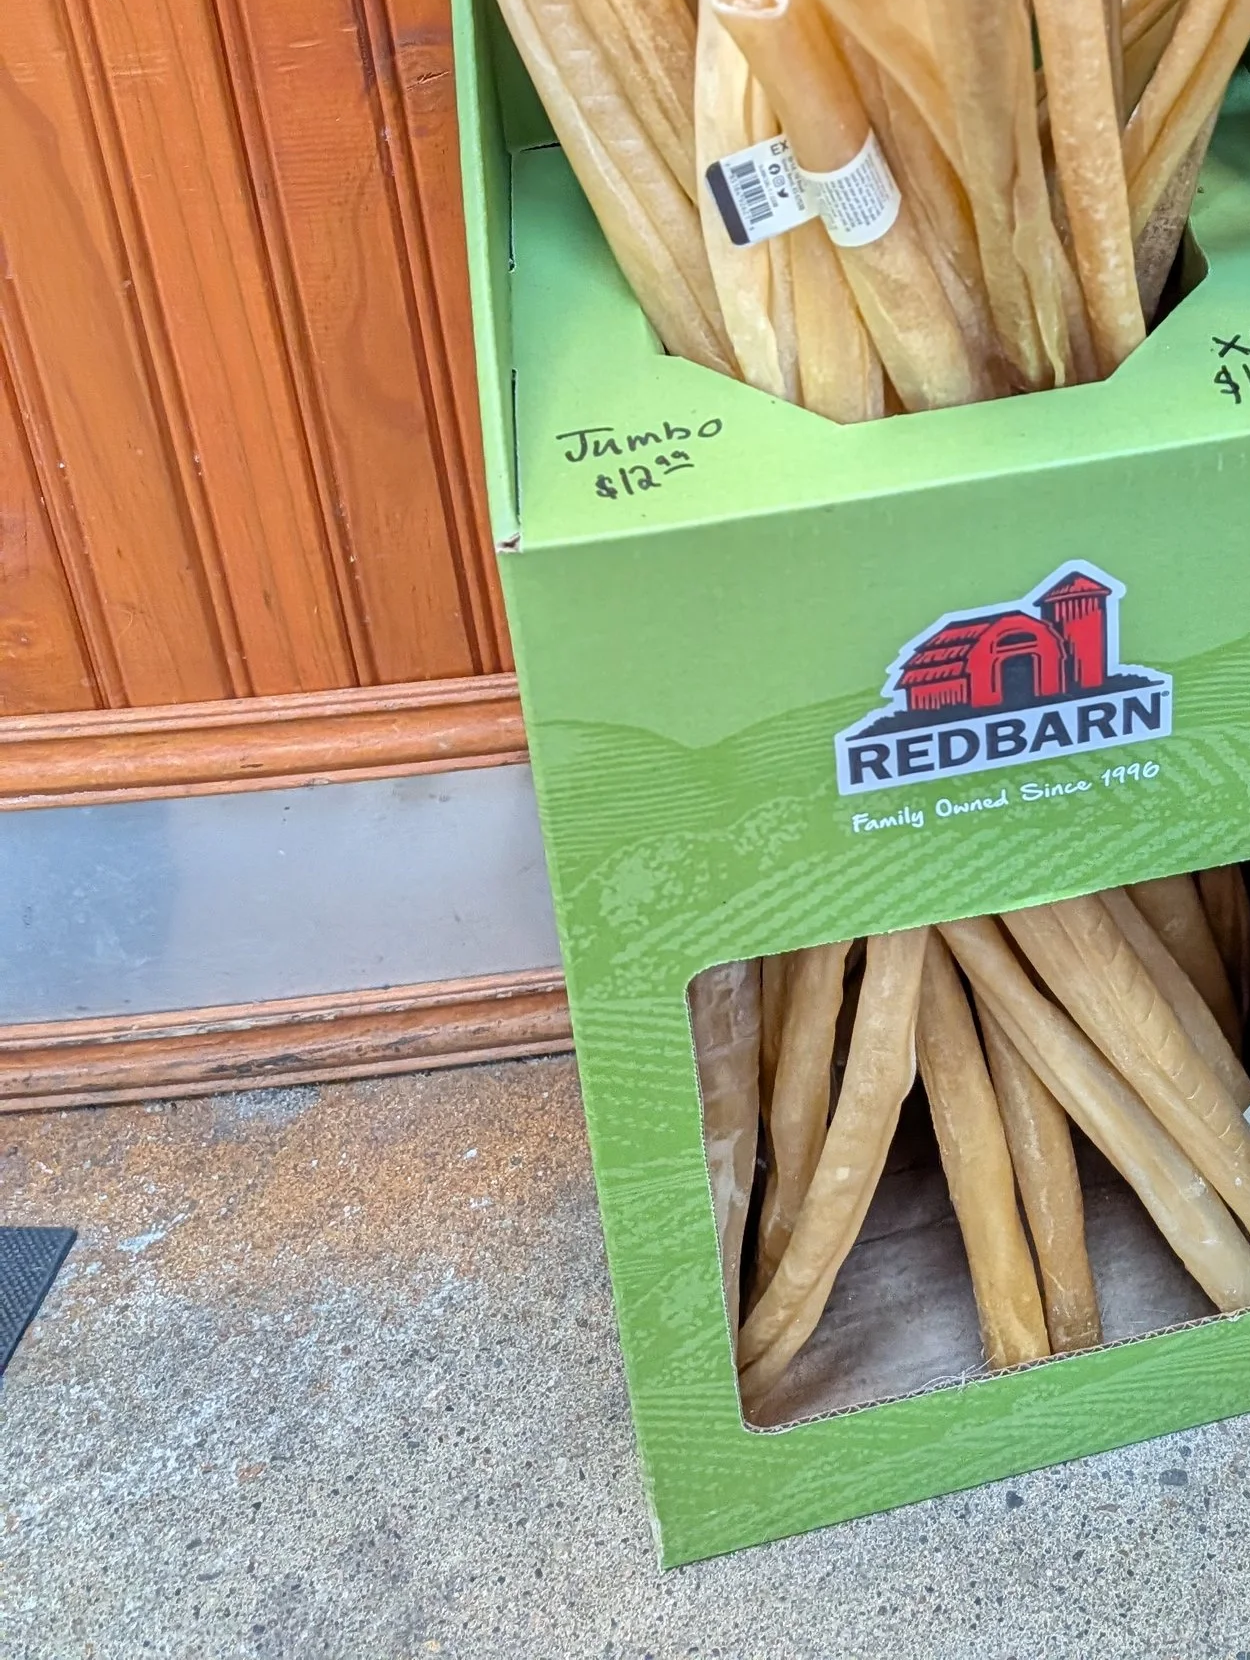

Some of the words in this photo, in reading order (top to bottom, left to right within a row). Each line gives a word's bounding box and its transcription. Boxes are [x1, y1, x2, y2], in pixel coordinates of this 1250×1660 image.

[556, 418, 722, 462] Jumbo
[848, 691, 1162, 785] REDBARN
[851, 806, 924, 833] Family
[935, 789, 1009, 818] Owned
[1019, 780, 1092, 802] Since
[1100, 760, 1160, 787] 1996
